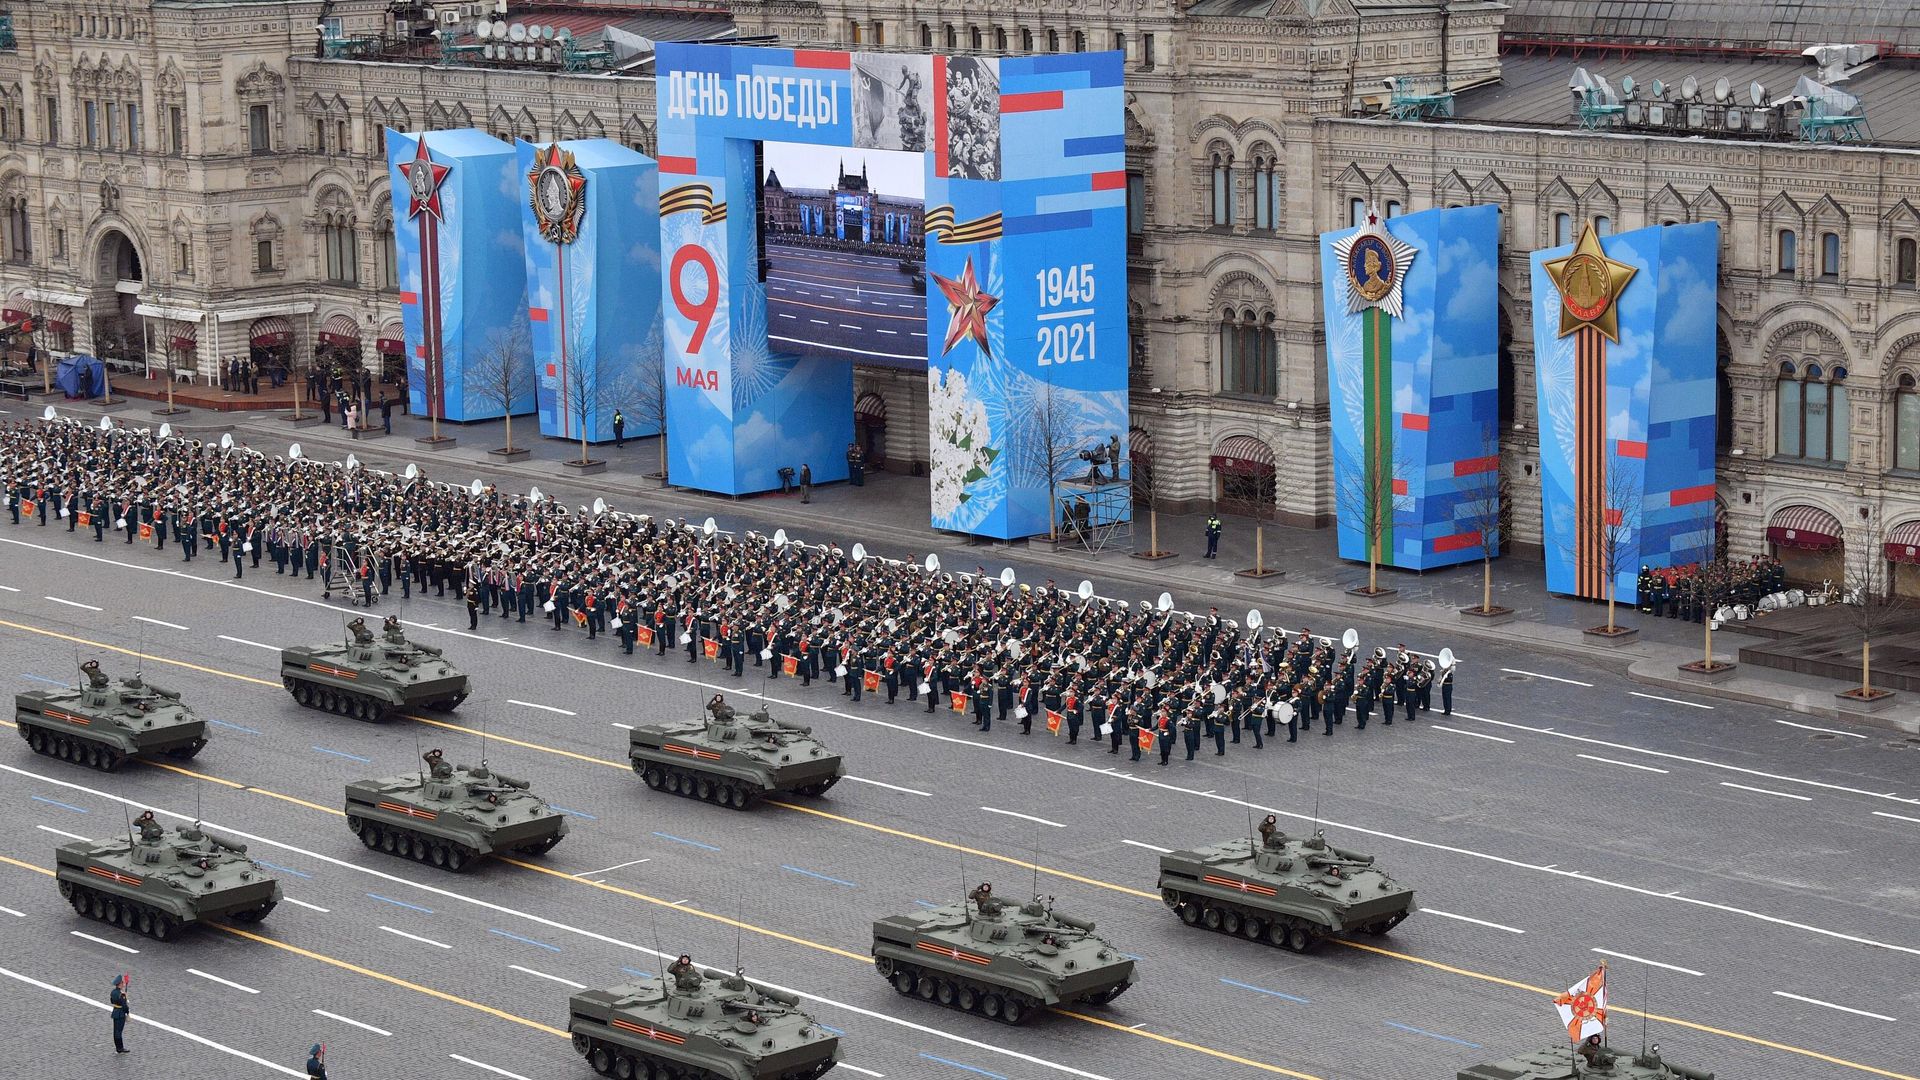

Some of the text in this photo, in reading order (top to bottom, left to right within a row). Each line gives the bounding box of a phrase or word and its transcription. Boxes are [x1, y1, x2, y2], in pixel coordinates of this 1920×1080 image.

[667, 70, 838, 129] ДЕНЬ ПОБЕДЫ
[669, 243, 720, 355] 9
[1036, 263, 1095, 308] 1945
[1570, 303, 1603, 318] СЛАВА
[1037, 321, 1096, 367] 2021
[676, 366, 719, 392] МАЯ
